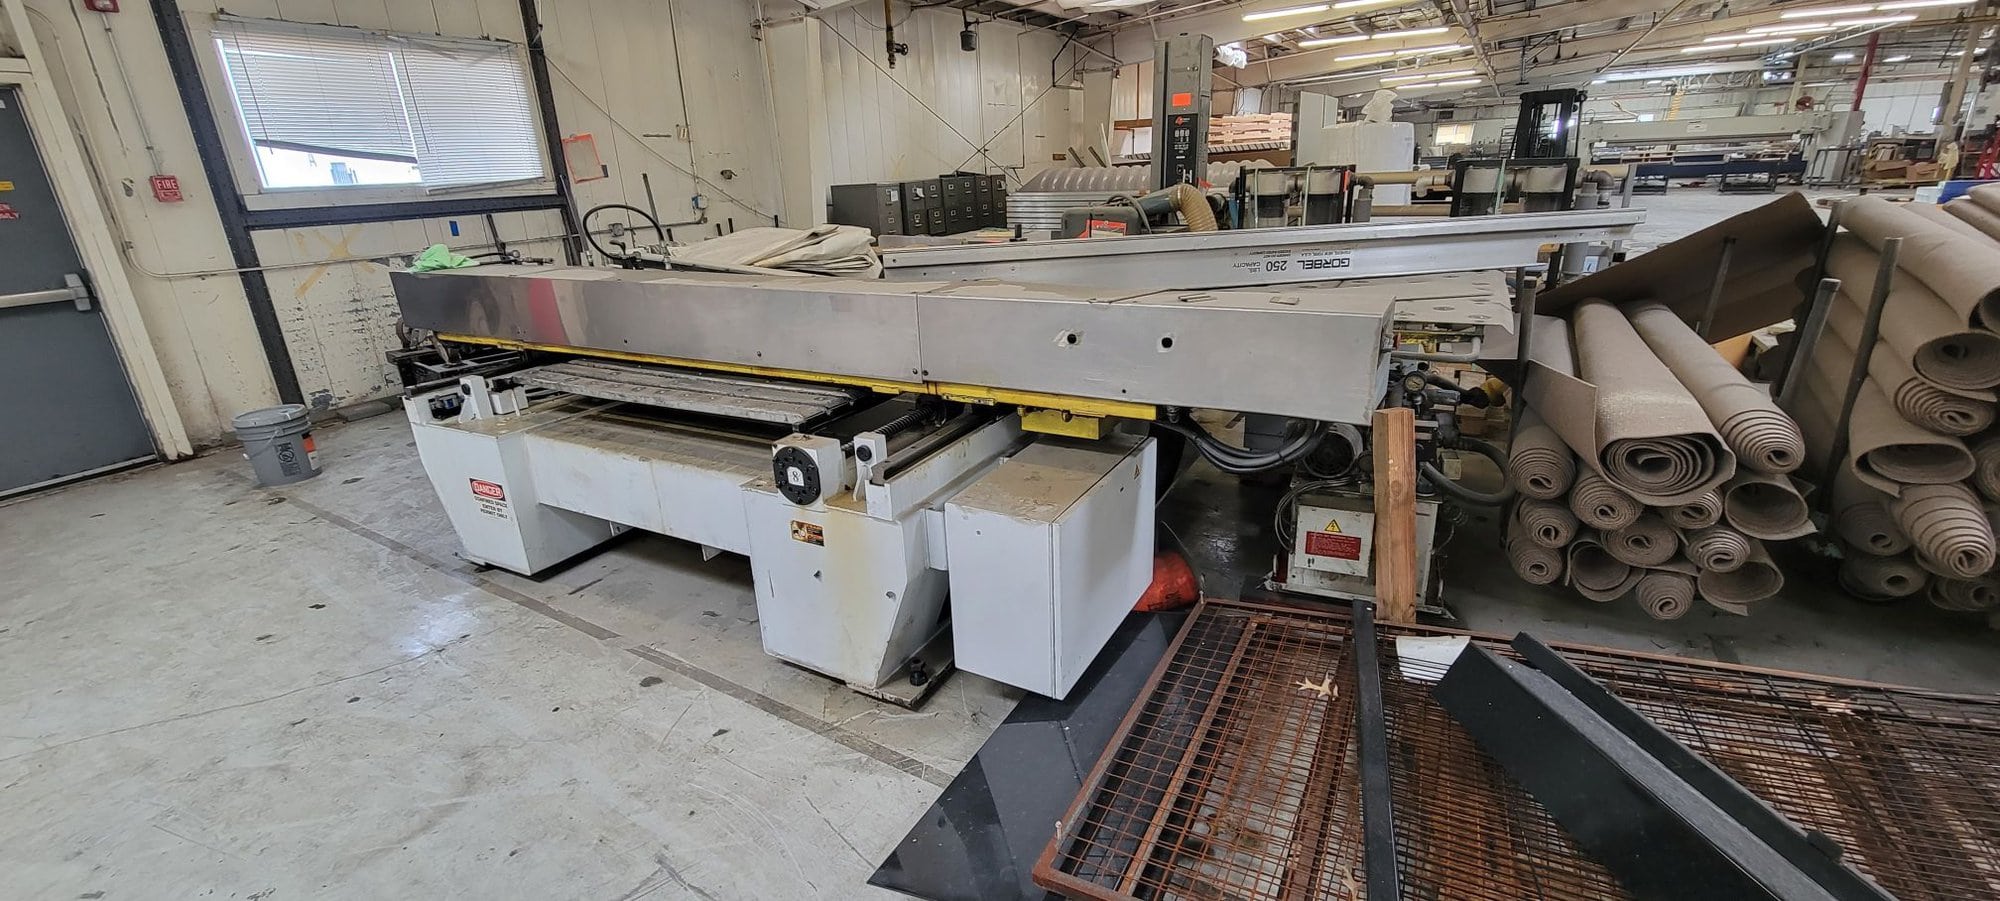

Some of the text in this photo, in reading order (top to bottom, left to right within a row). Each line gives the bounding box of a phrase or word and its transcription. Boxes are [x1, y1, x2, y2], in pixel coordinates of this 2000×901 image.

[156, 179, 178, 189] FIRE
[1266, 260, 1287, 271] 250
[1297, 258, 1350, 270] GORBEL
[792, 471, 800, 482] 8
[474, 482, 501, 496] DANGER
